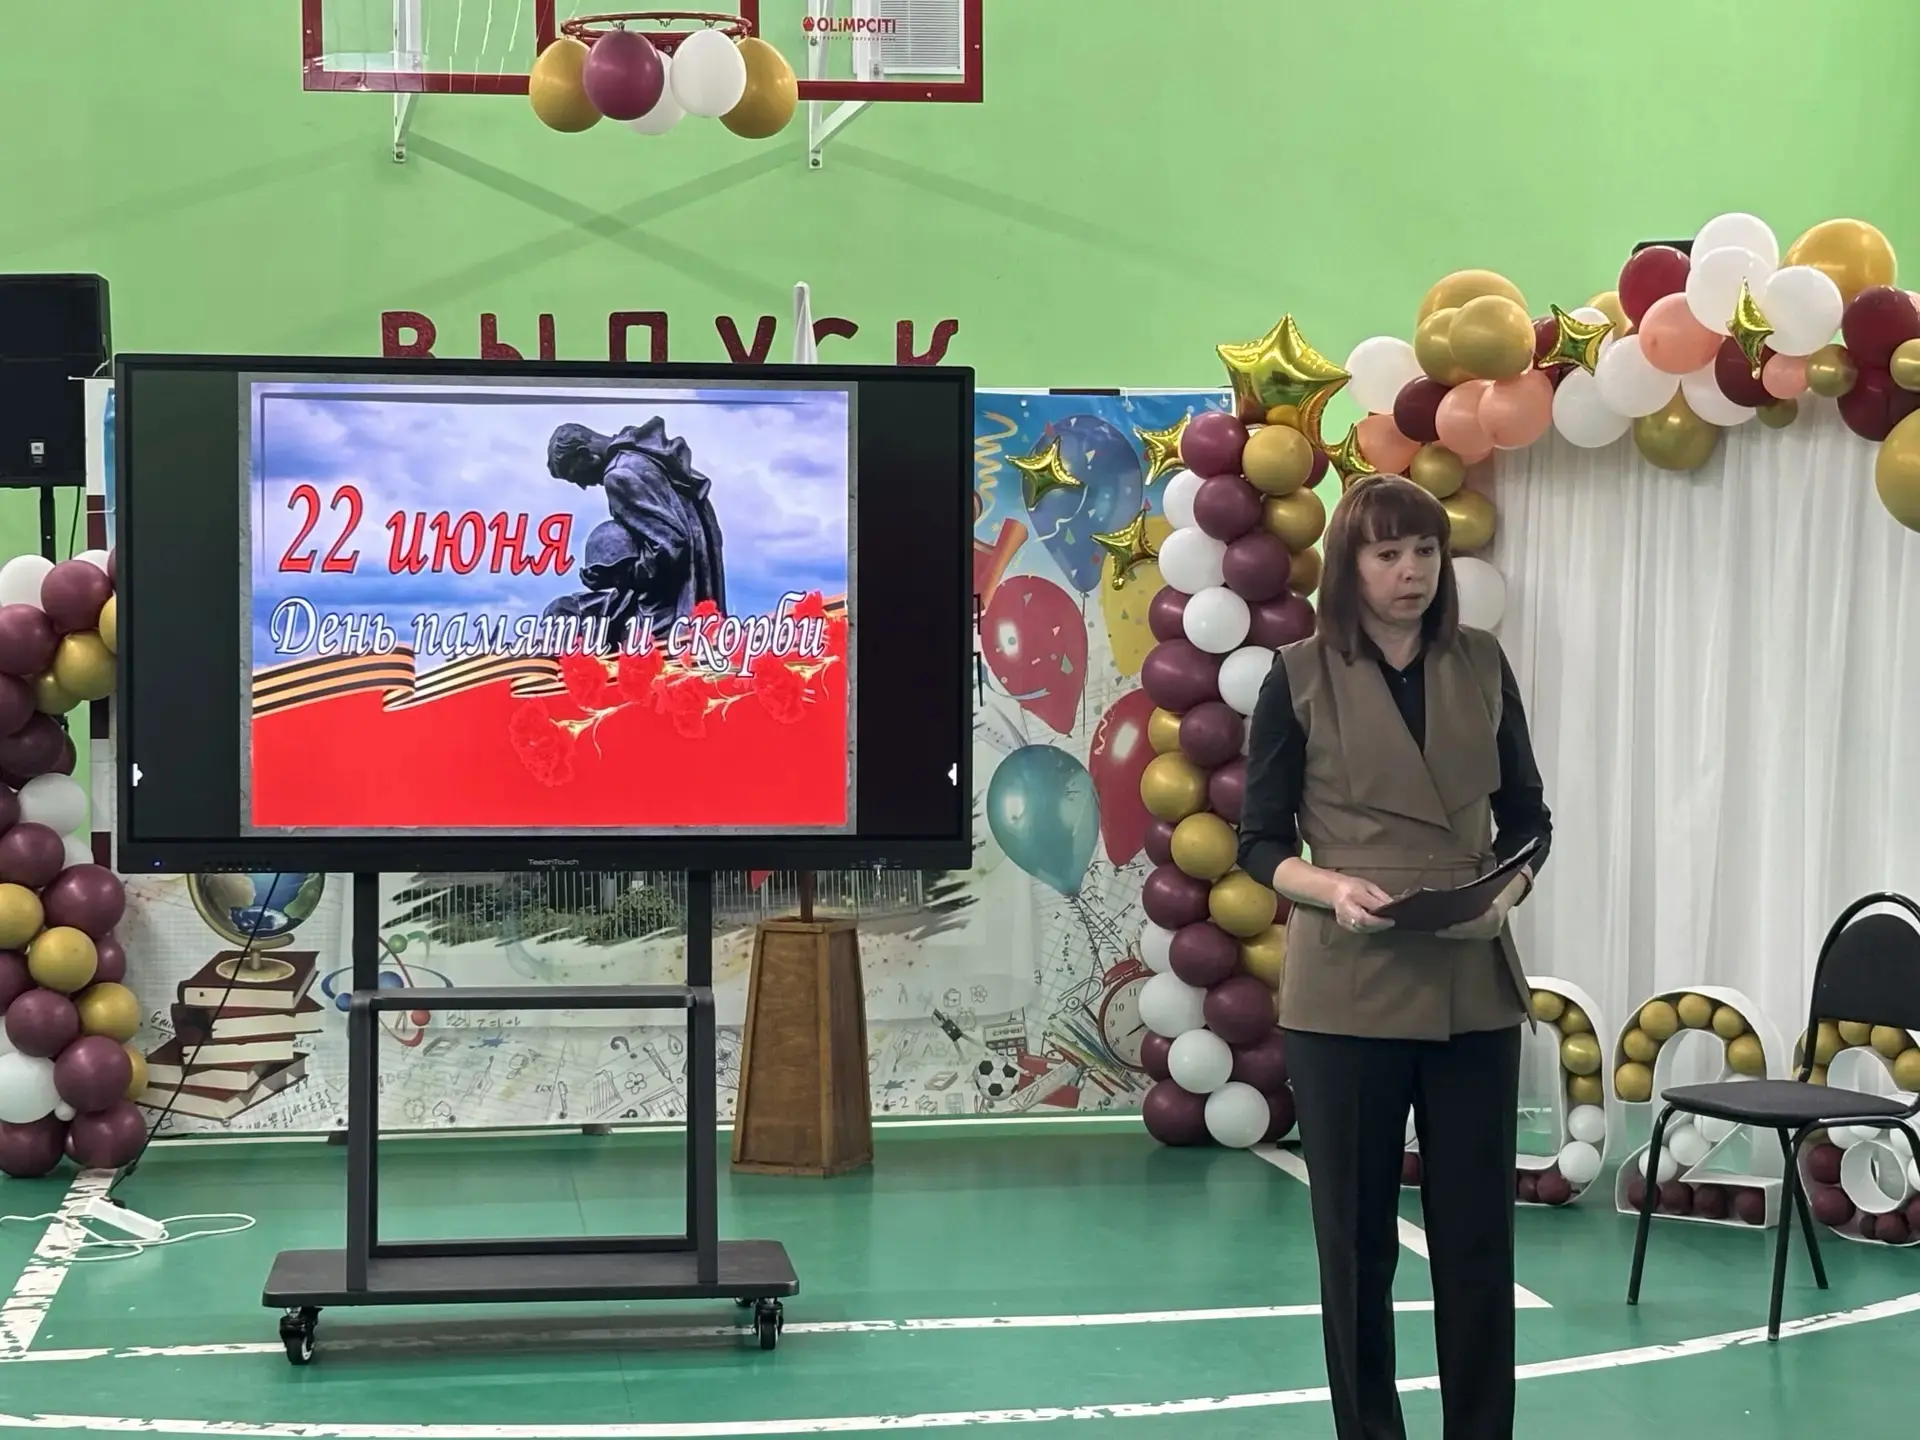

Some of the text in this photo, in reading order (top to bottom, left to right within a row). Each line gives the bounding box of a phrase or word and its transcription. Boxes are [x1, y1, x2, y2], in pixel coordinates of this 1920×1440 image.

[278, 484, 575, 575] 22 июня
[270, 591, 826, 678] День памяти и скорби
[1128, 988, 1137, 997] 11
[1114, 1003, 1125, 1012] 10
[1109, 1020, 1116, 1028] 9
[1129, 1049, 1135, 1057] 7
